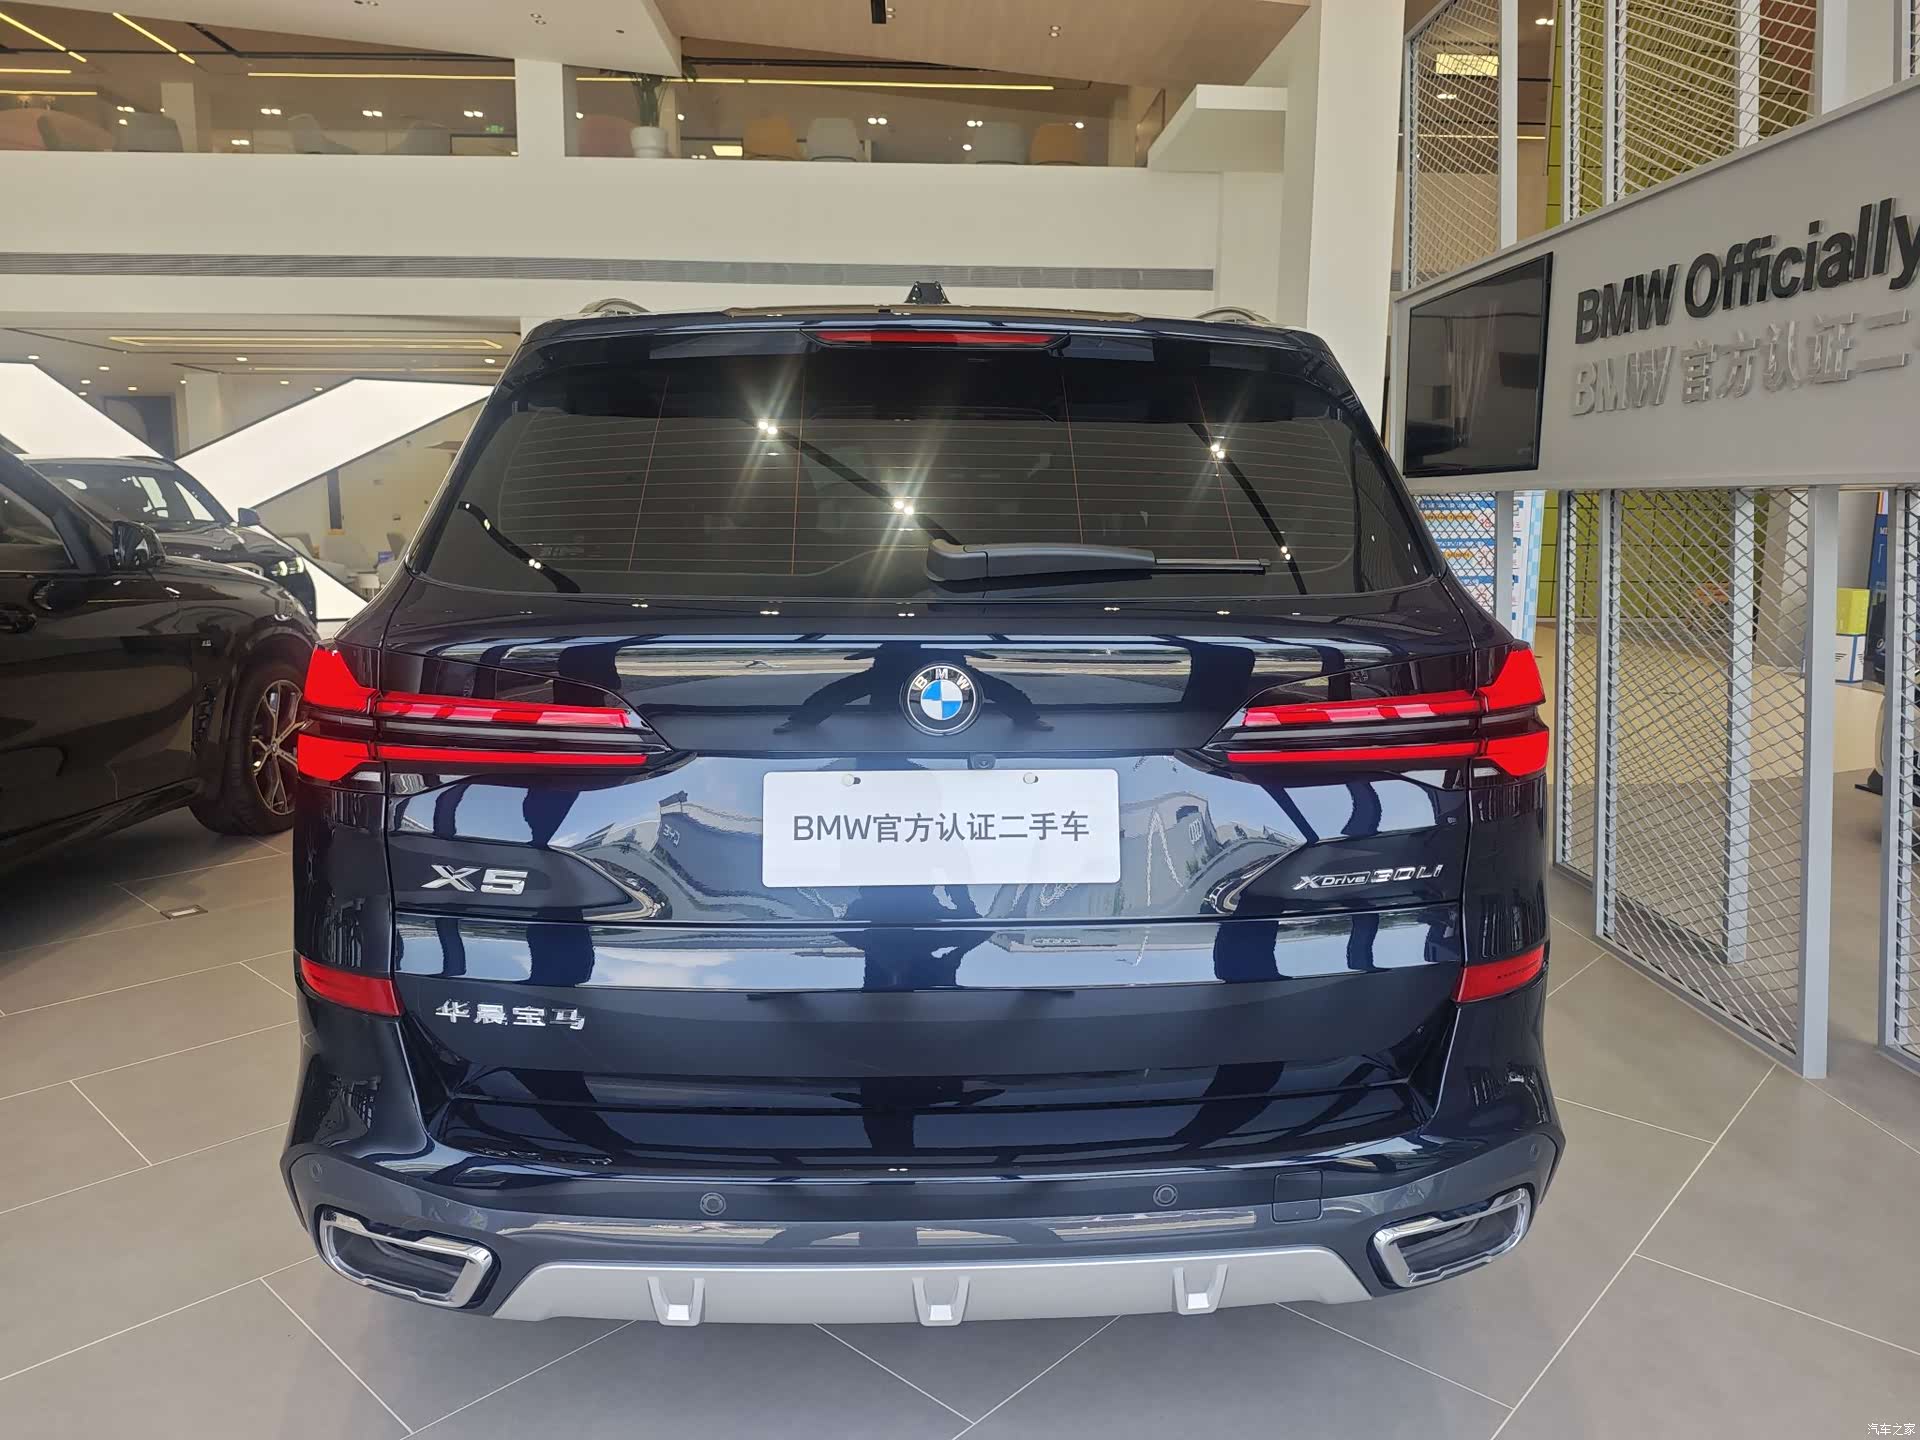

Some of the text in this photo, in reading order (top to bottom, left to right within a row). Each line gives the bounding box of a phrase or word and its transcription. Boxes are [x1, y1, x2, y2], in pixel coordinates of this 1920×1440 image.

[1575, 197, 1920, 345] BMW Officially
[1572, 345, 1680, 416] BMW
[914, 667, 970, 691] BMW
[792, 810, 1090, 844] BMW官方认证二手车
[420, 864, 530, 896] X5
[435, 998, 586, 1031] 华晨宝马
